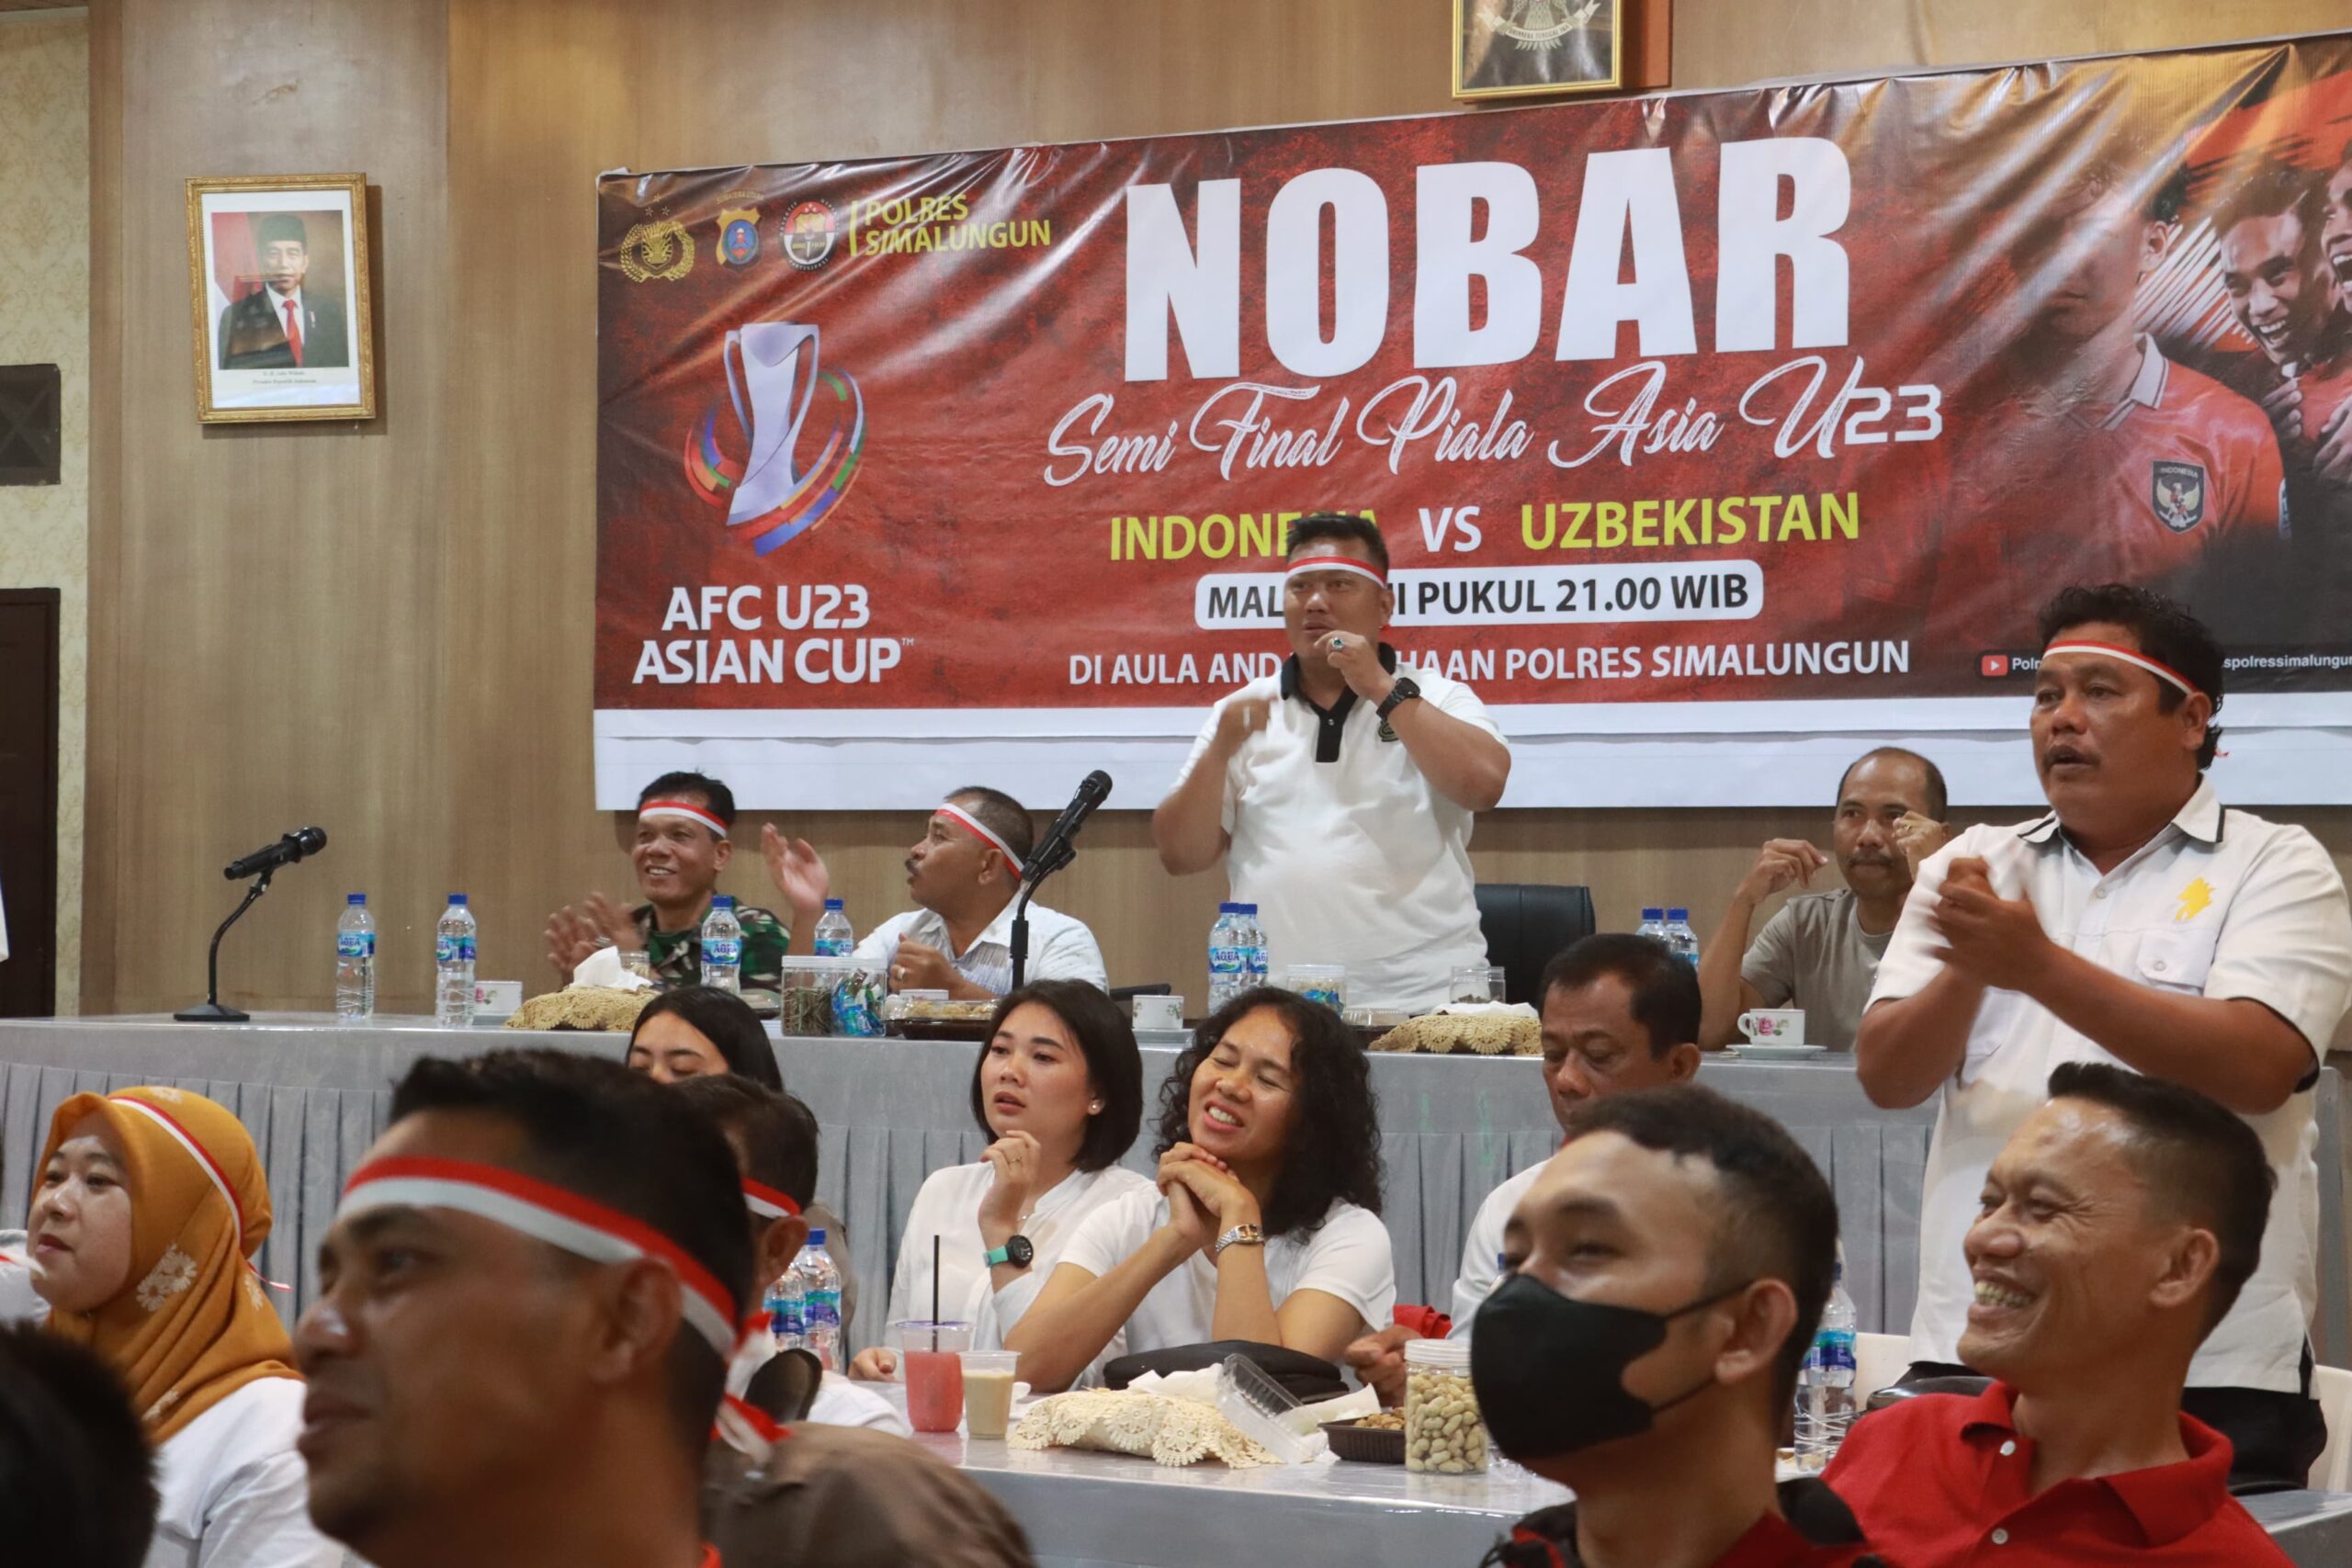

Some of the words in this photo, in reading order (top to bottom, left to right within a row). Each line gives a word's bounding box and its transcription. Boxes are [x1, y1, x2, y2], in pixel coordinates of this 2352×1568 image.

[865, 194, 969, 226] POLRES
[865, 220, 1051, 256] SIMALUNGUN
[1125, 136, 1852, 382] NOBAR
[1044, 393, 1178, 487] Semi
[1190, 382, 1350, 480] Final
[1356, 376, 1534, 475] Piala
[1548, 360, 1724, 468] Asia
[1738, 355, 1943, 458] U23
[1110, 510, 1377, 561] INDONE
[1419, 506, 1482, 552] VS
[1521, 491, 1860, 550] UZBEKISTAN
[662, 586, 762, 631] AFC
[776, 584, 870, 630] U23
[1207, 586, 1285, 619] MAL
[1418, 580, 1545, 615] PUKUL
[1556, 576, 1661, 613] 21.00
[1670, 574, 1748, 610] WIB
[632, 639, 784, 684] ASIAN
[795, 637, 901, 684] CUP
[1069, 654, 1102, 685] DI
[1110, 653, 1199, 684] AULA
[1506, 647, 1643, 681] POLRES
[1651, 640, 1910, 678] SIMALUNGUN
[2011, 657, 2042, 671] Polr
[1214, 951, 1240, 962] AQUA
